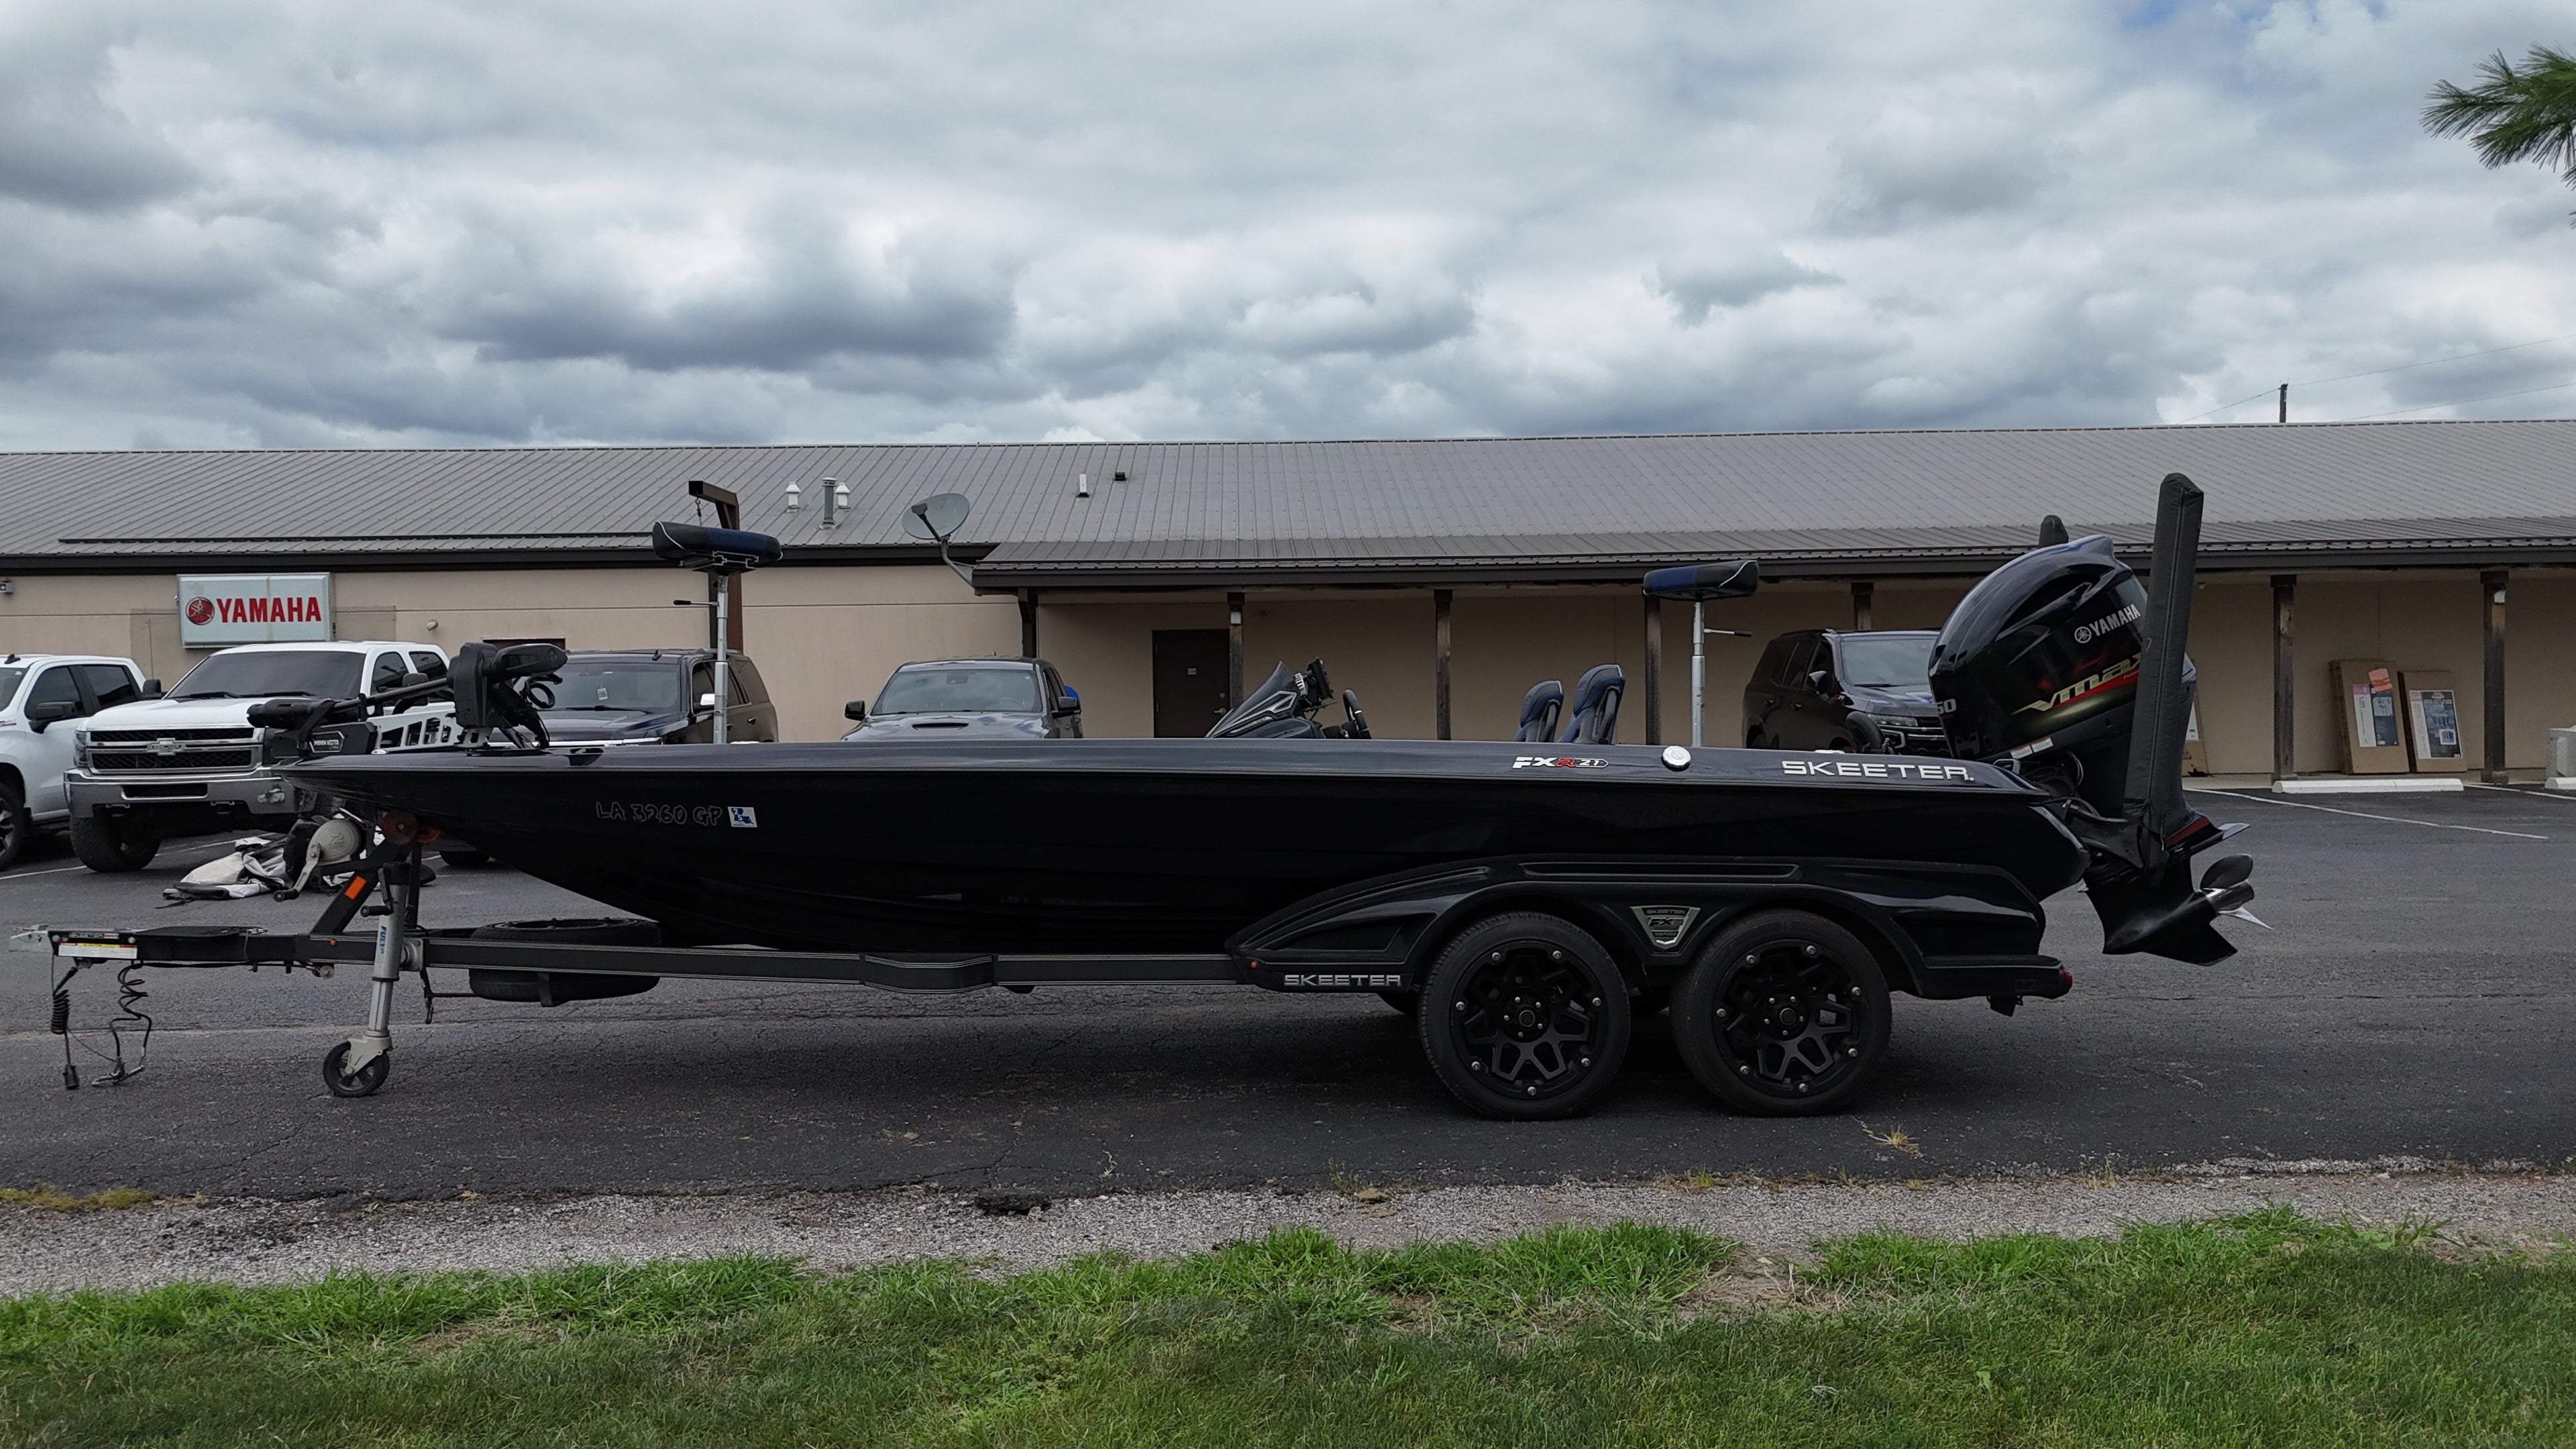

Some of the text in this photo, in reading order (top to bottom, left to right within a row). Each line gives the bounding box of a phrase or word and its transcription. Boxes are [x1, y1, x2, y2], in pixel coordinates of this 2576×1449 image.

[216, 596, 322, 623] YAMAHA
[2089, 604, 2141, 637] YAMAHA
[1781, 761, 1970, 781] SKEETER
[596, 802, 626, 821] LA
[692, 806, 722, 826] GP
[1284, 975, 1401, 987] SKEETER
